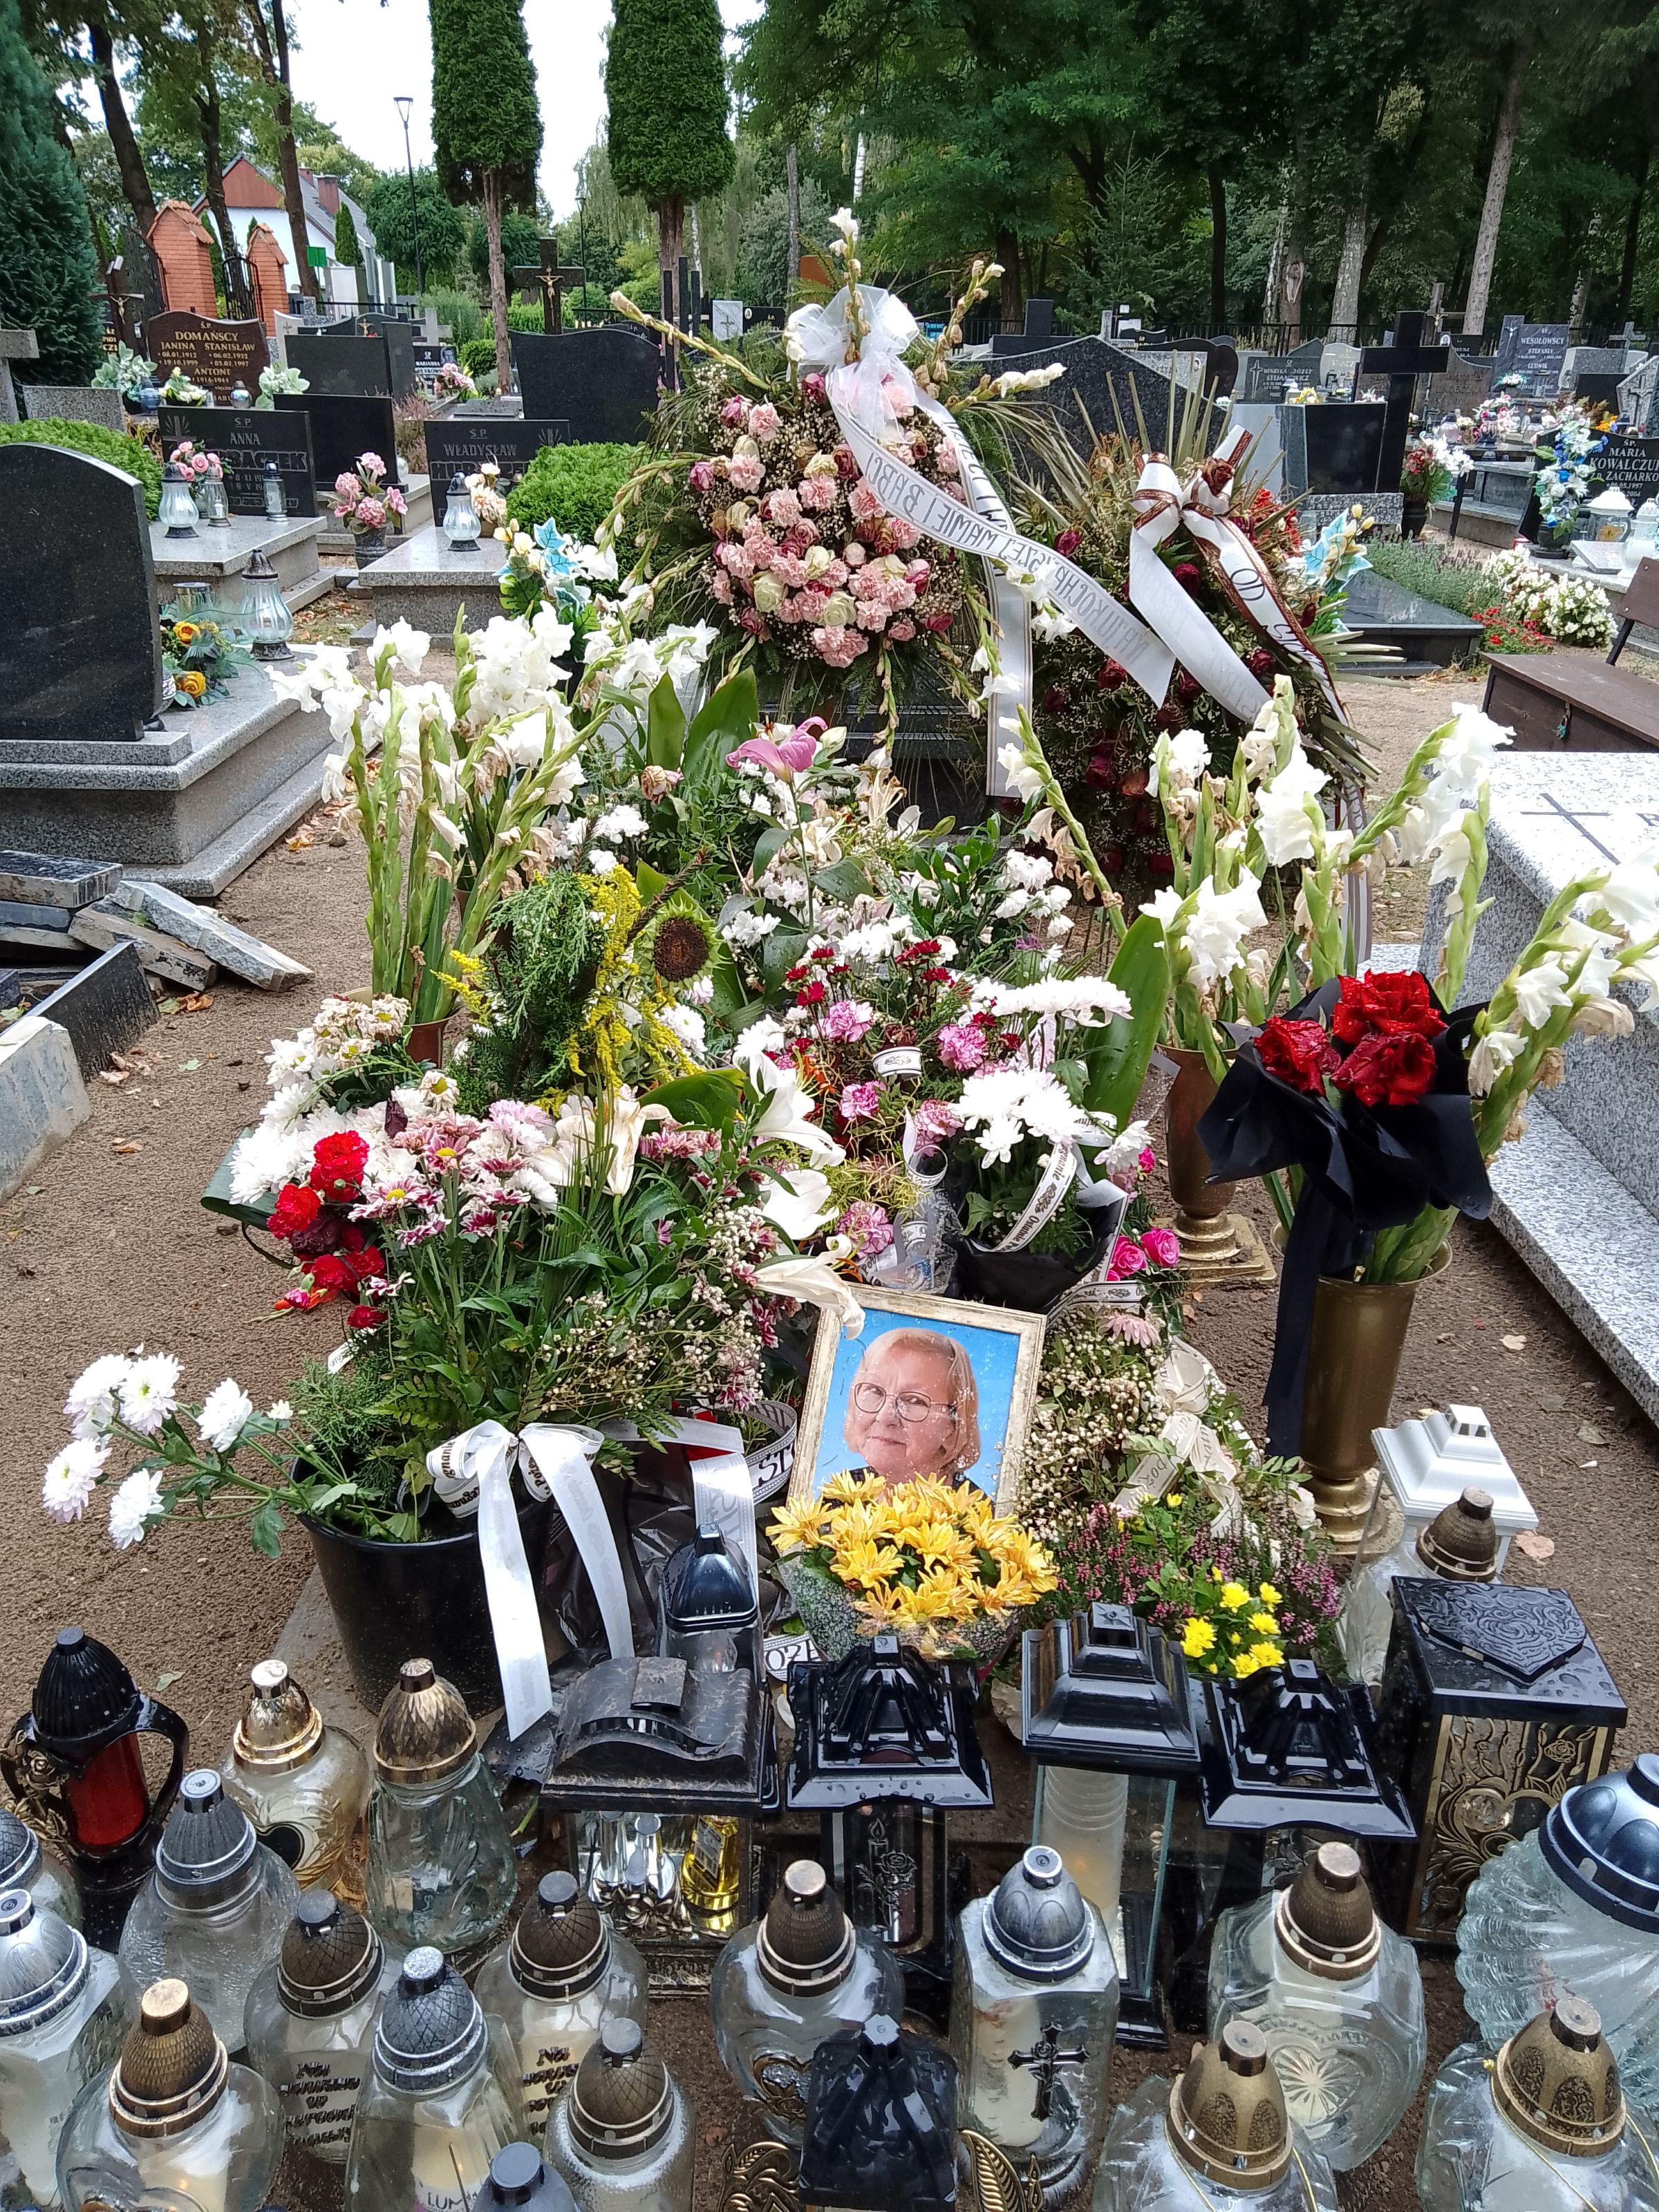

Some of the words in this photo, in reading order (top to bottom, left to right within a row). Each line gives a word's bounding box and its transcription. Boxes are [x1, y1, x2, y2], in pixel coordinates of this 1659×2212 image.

[175, 330, 238, 341] DOMAŃSCY
[160, 341, 196, 350] JANINA
[204, 343, 256, 351] STANISŁAW
[230, 432, 261, 446] ANNA
[443, 444, 517, 456] WŁADYSŁAW
[1609, 447, 1647, 458] MARIA
